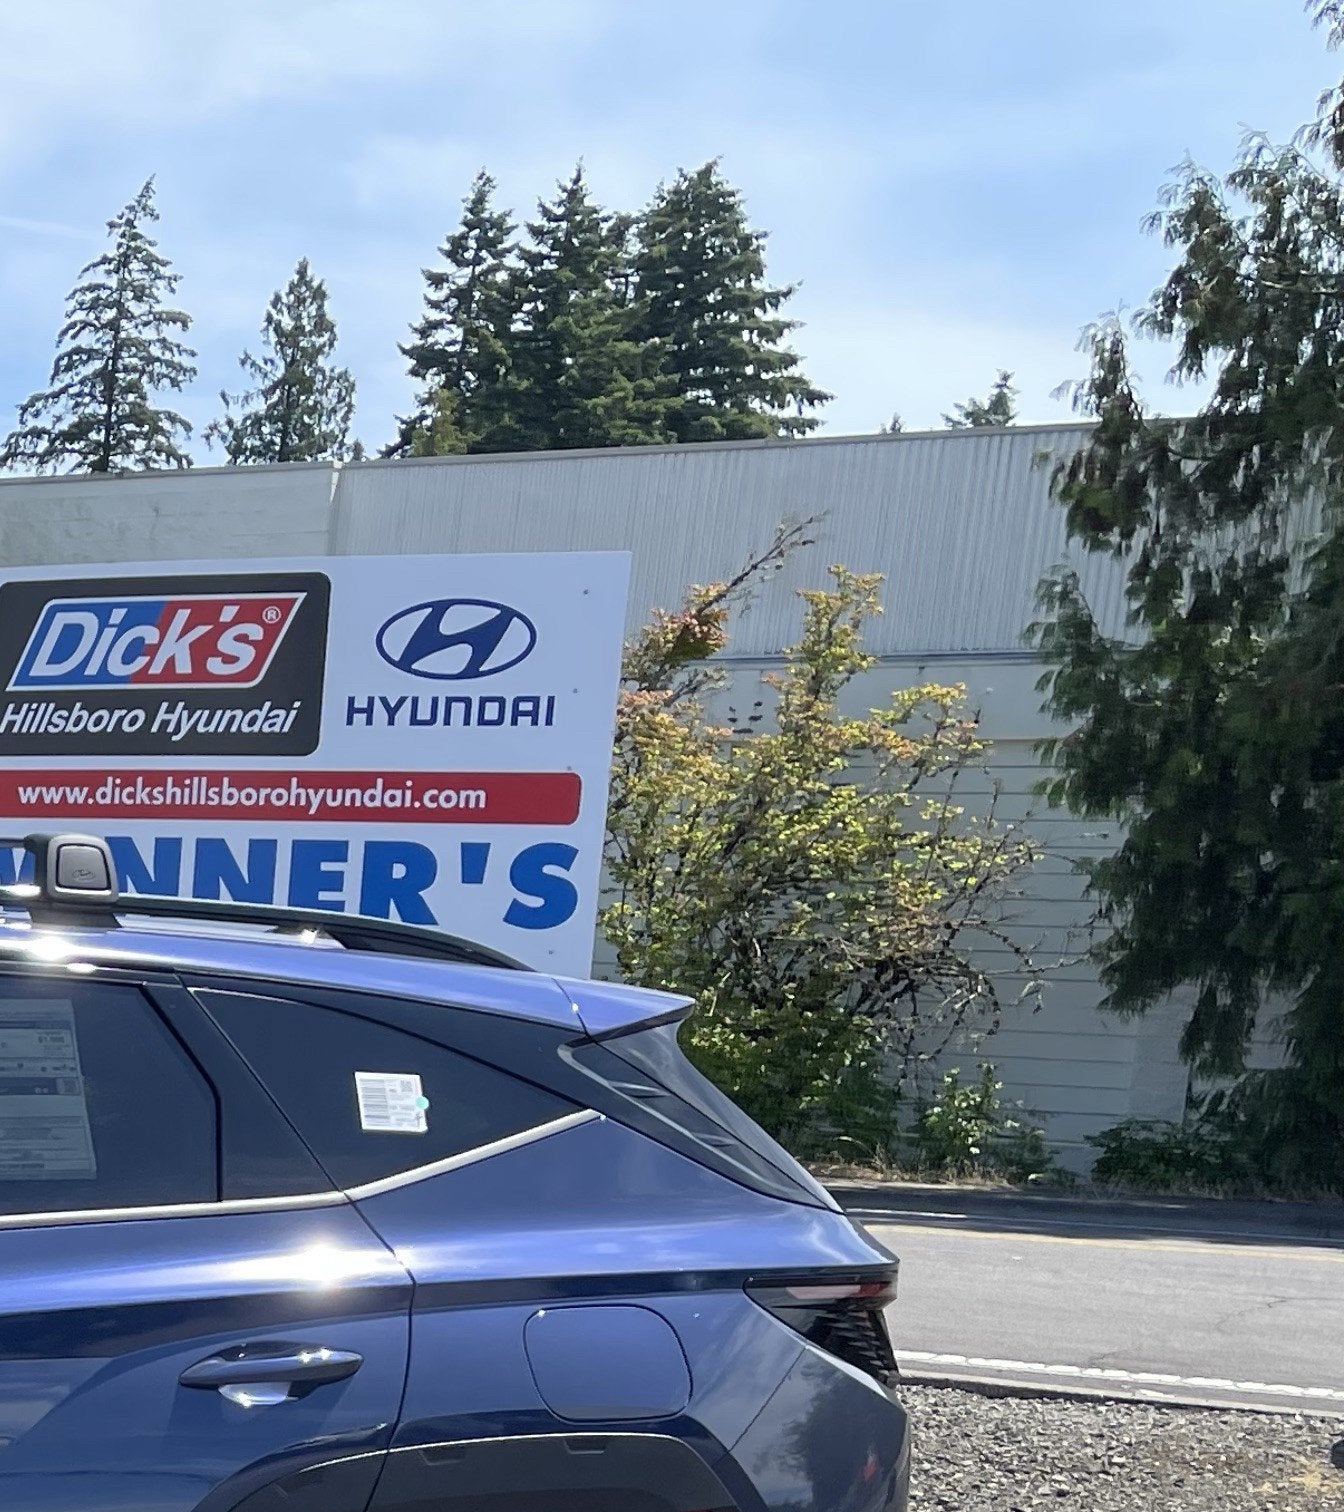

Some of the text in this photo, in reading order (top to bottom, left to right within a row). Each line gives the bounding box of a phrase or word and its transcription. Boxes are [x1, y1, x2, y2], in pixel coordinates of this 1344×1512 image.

[26, 604, 266, 678] Dick's
[153, 701, 301, 741] Hyundai
[346, 694, 556, 728] HYUNDAI
[17, 776, 487, 814] www.dickshillsborohyundai.com
